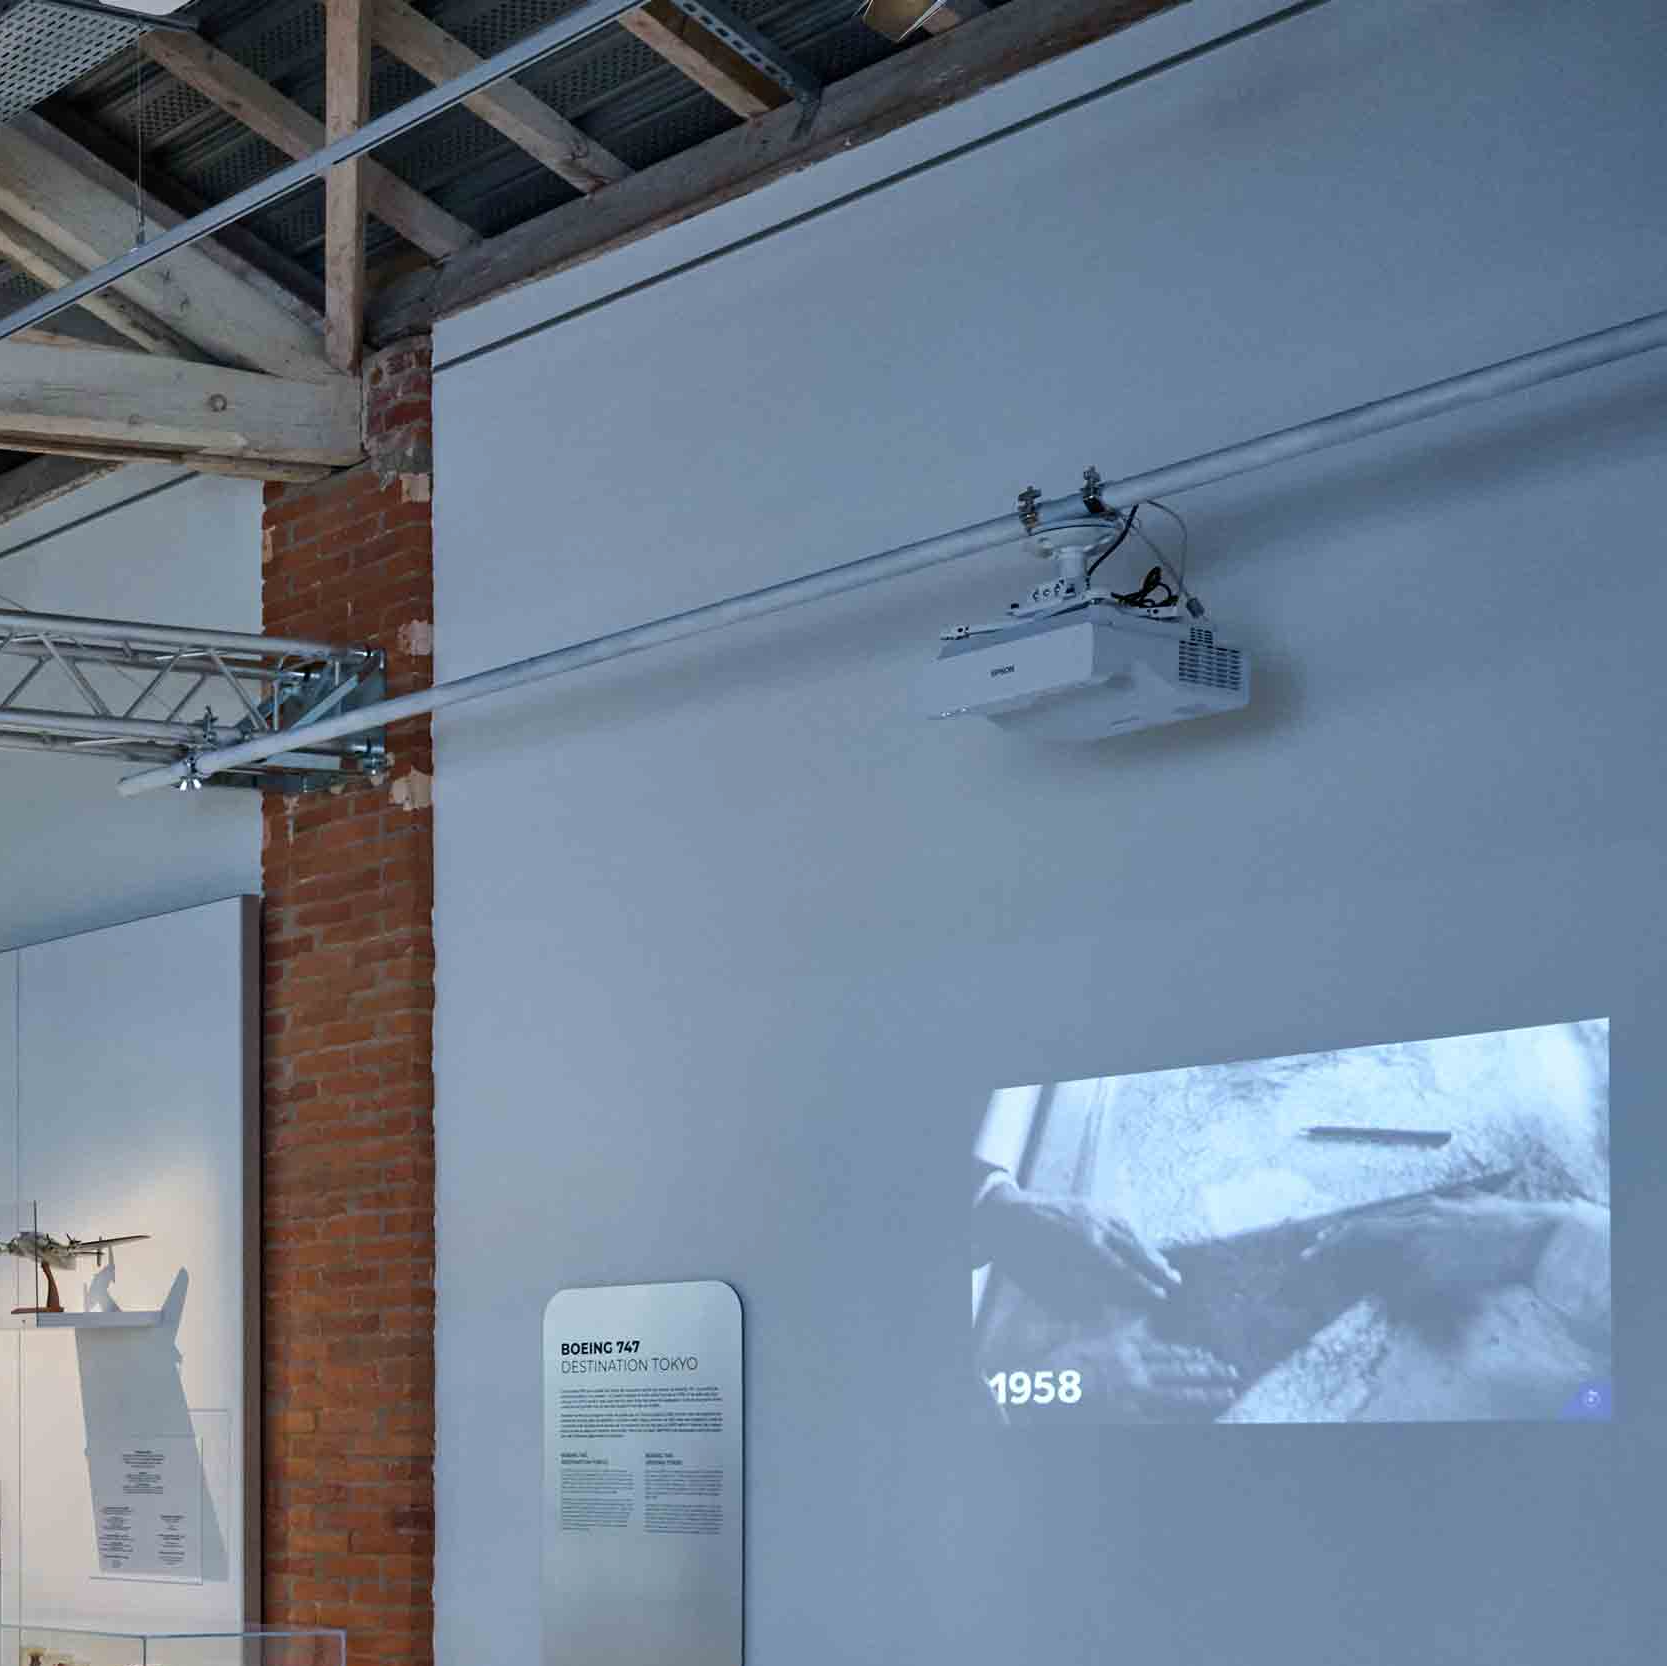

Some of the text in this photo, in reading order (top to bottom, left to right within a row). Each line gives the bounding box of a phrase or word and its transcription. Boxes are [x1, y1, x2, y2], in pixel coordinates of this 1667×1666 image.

[561, 1340, 640, 1356] BOEING 747
[561, 1356, 699, 1374] DESTINATION TOKYO
[989, 1369, 1083, 1404] 1958
